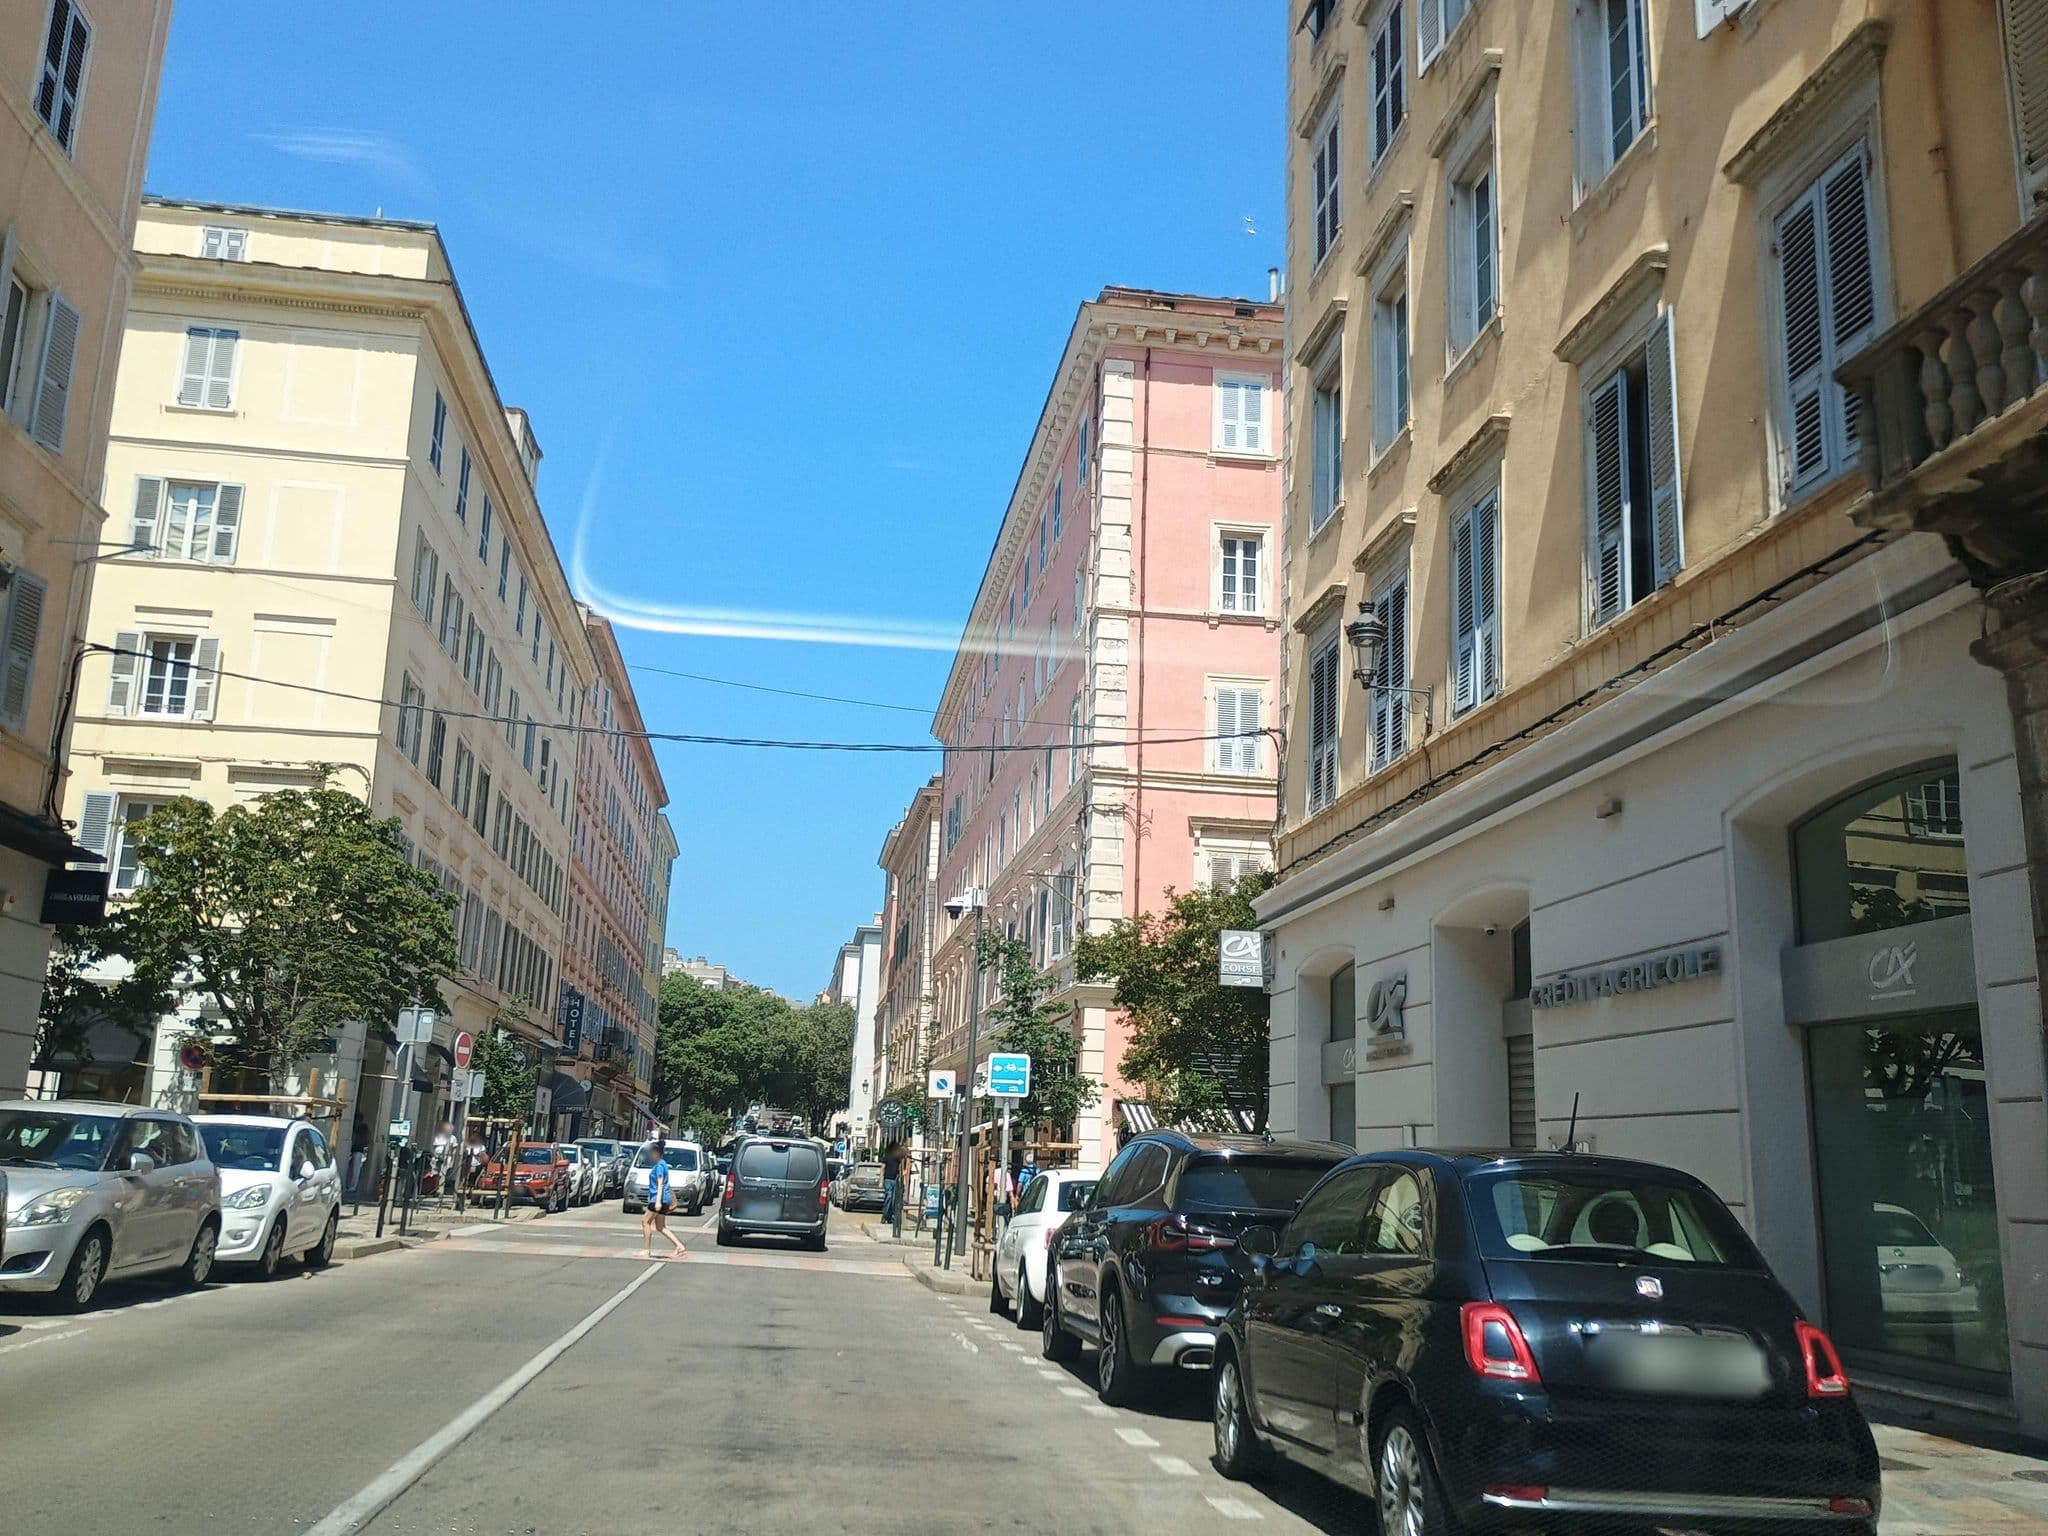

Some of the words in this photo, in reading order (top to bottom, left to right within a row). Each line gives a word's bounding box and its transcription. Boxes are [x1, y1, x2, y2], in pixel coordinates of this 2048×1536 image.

[1222, 963, 1261, 973] CORSE
[1599, 945, 1723, 998] AGRICOLE
[567, 998, 581, 1050] HOTEL
